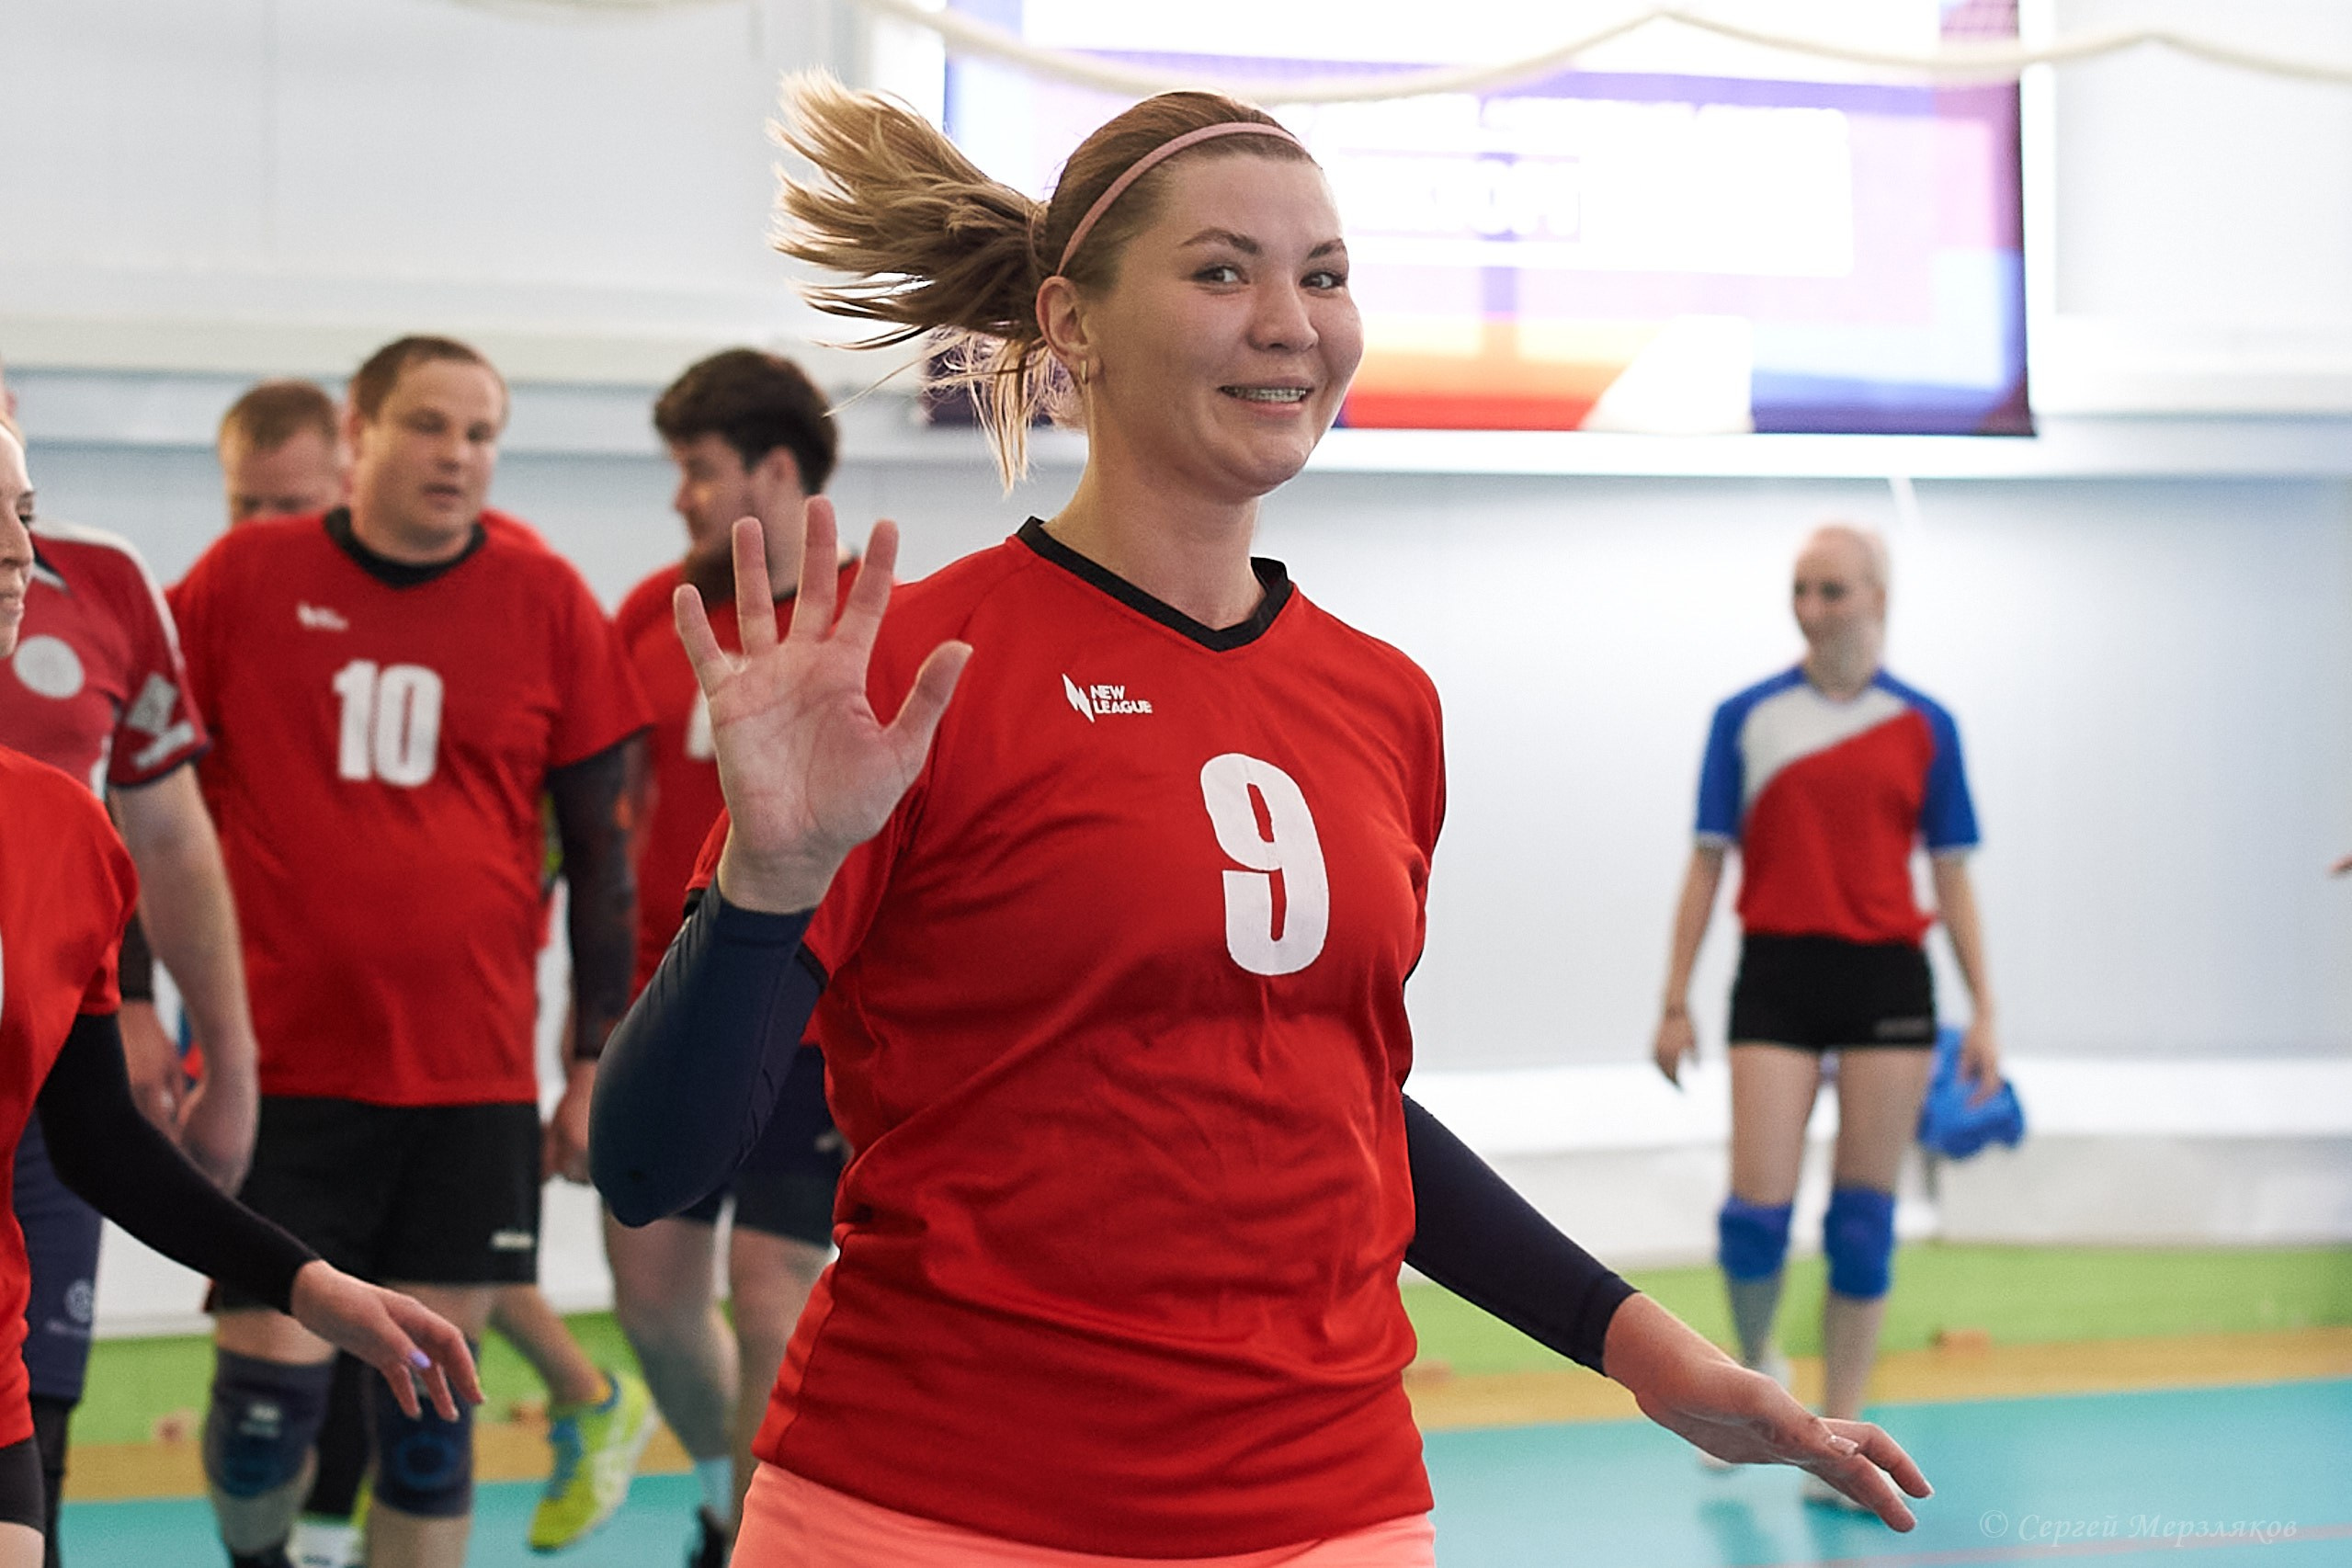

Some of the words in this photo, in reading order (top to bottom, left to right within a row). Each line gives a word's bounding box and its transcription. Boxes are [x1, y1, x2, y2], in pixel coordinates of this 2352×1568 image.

[333, 659, 444, 789] 10
[1090, 685, 1125, 699] NEW
[1093, 699, 1153, 714] LEAGUE
[1200, 753, 1330, 976] 9
